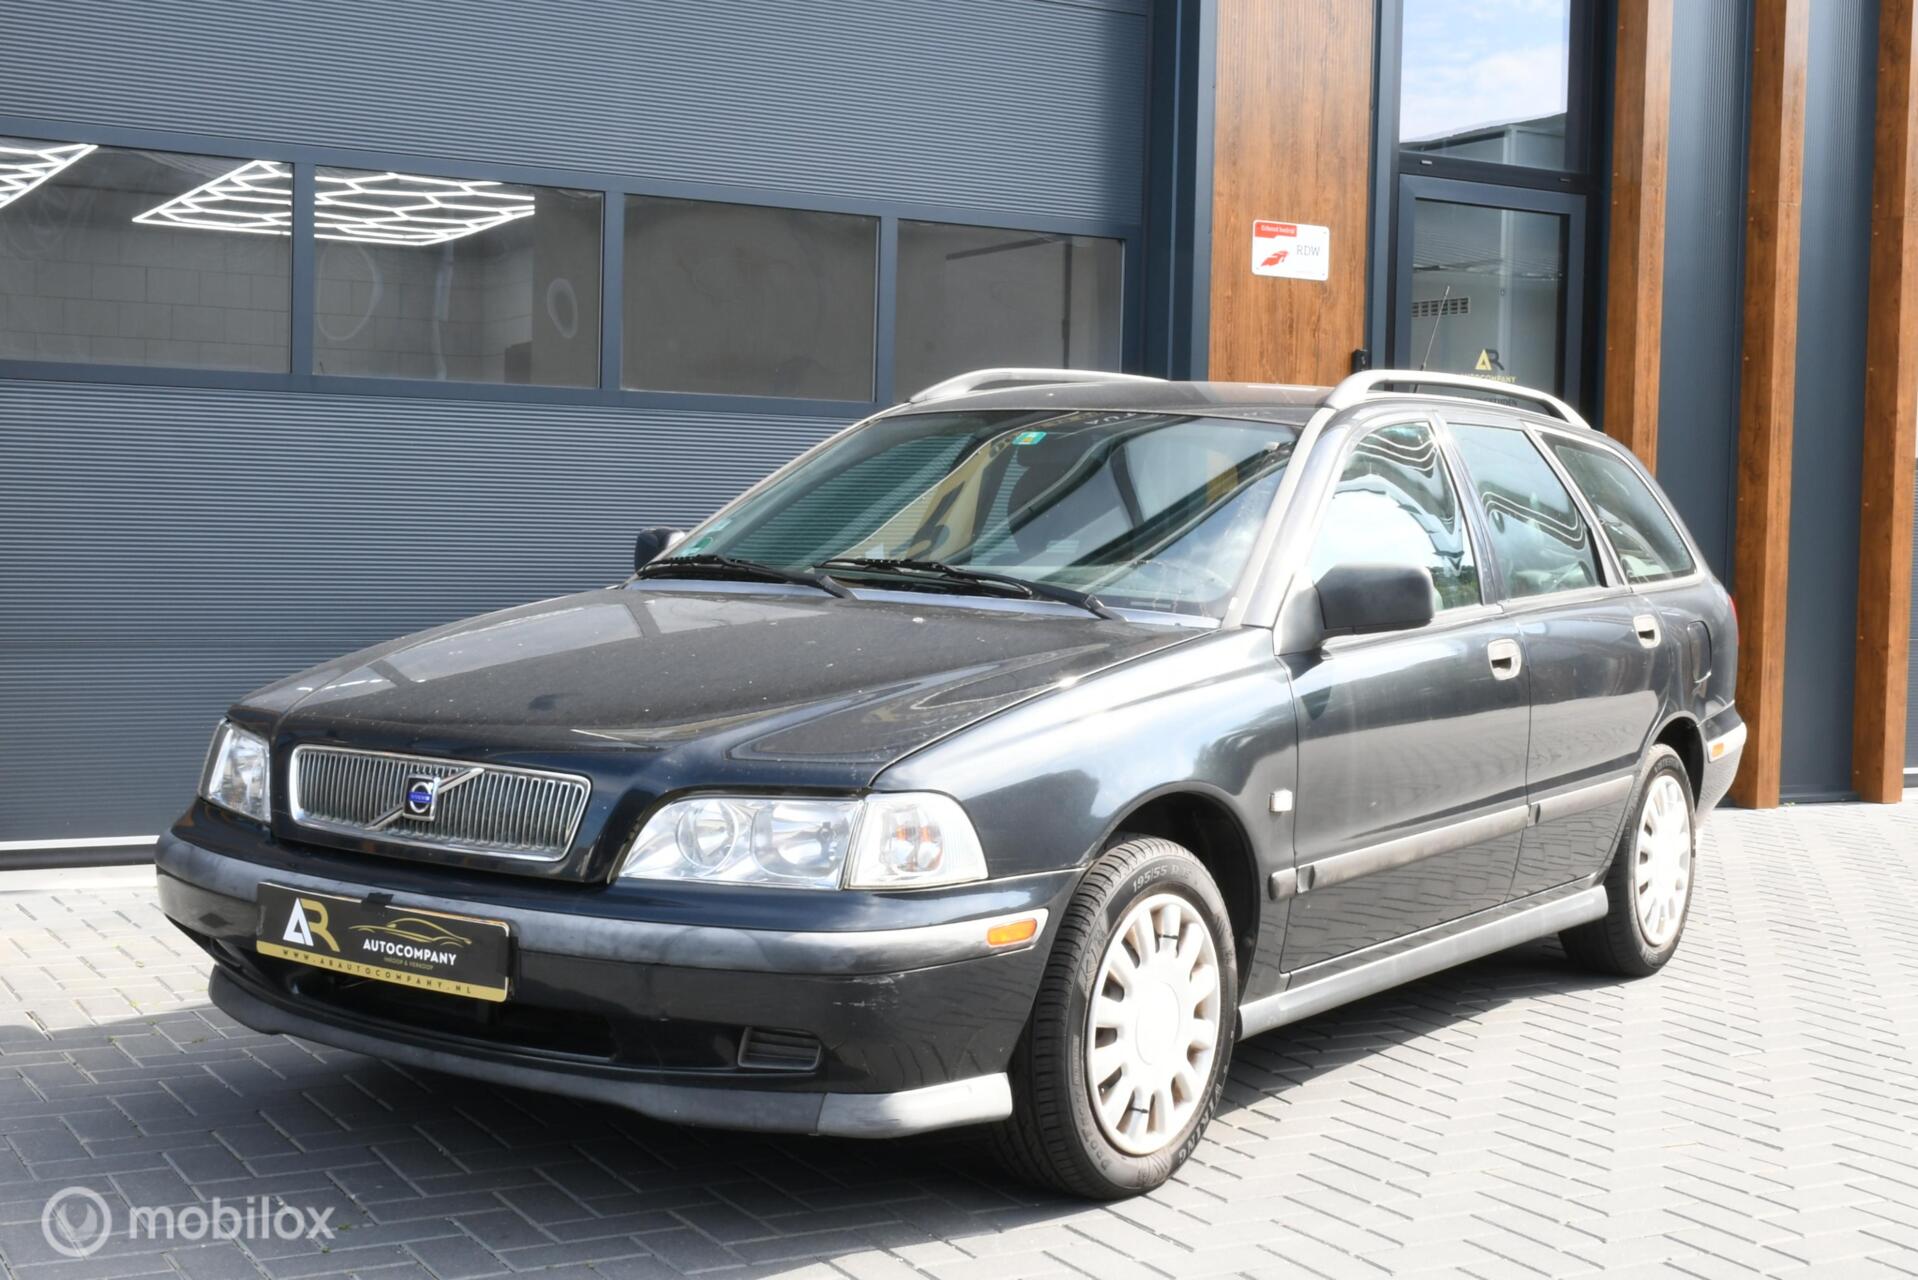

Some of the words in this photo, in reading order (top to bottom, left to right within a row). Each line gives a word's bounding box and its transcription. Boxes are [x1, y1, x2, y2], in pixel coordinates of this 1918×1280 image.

[1296, 244, 1321, 256] RDW
[1475, 348, 1505, 371] AR
[1132, 864, 1168, 893] 195/55
[282, 896, 341, 952] AR
[362, 938, 457, 966] AUTOCOMPANY
